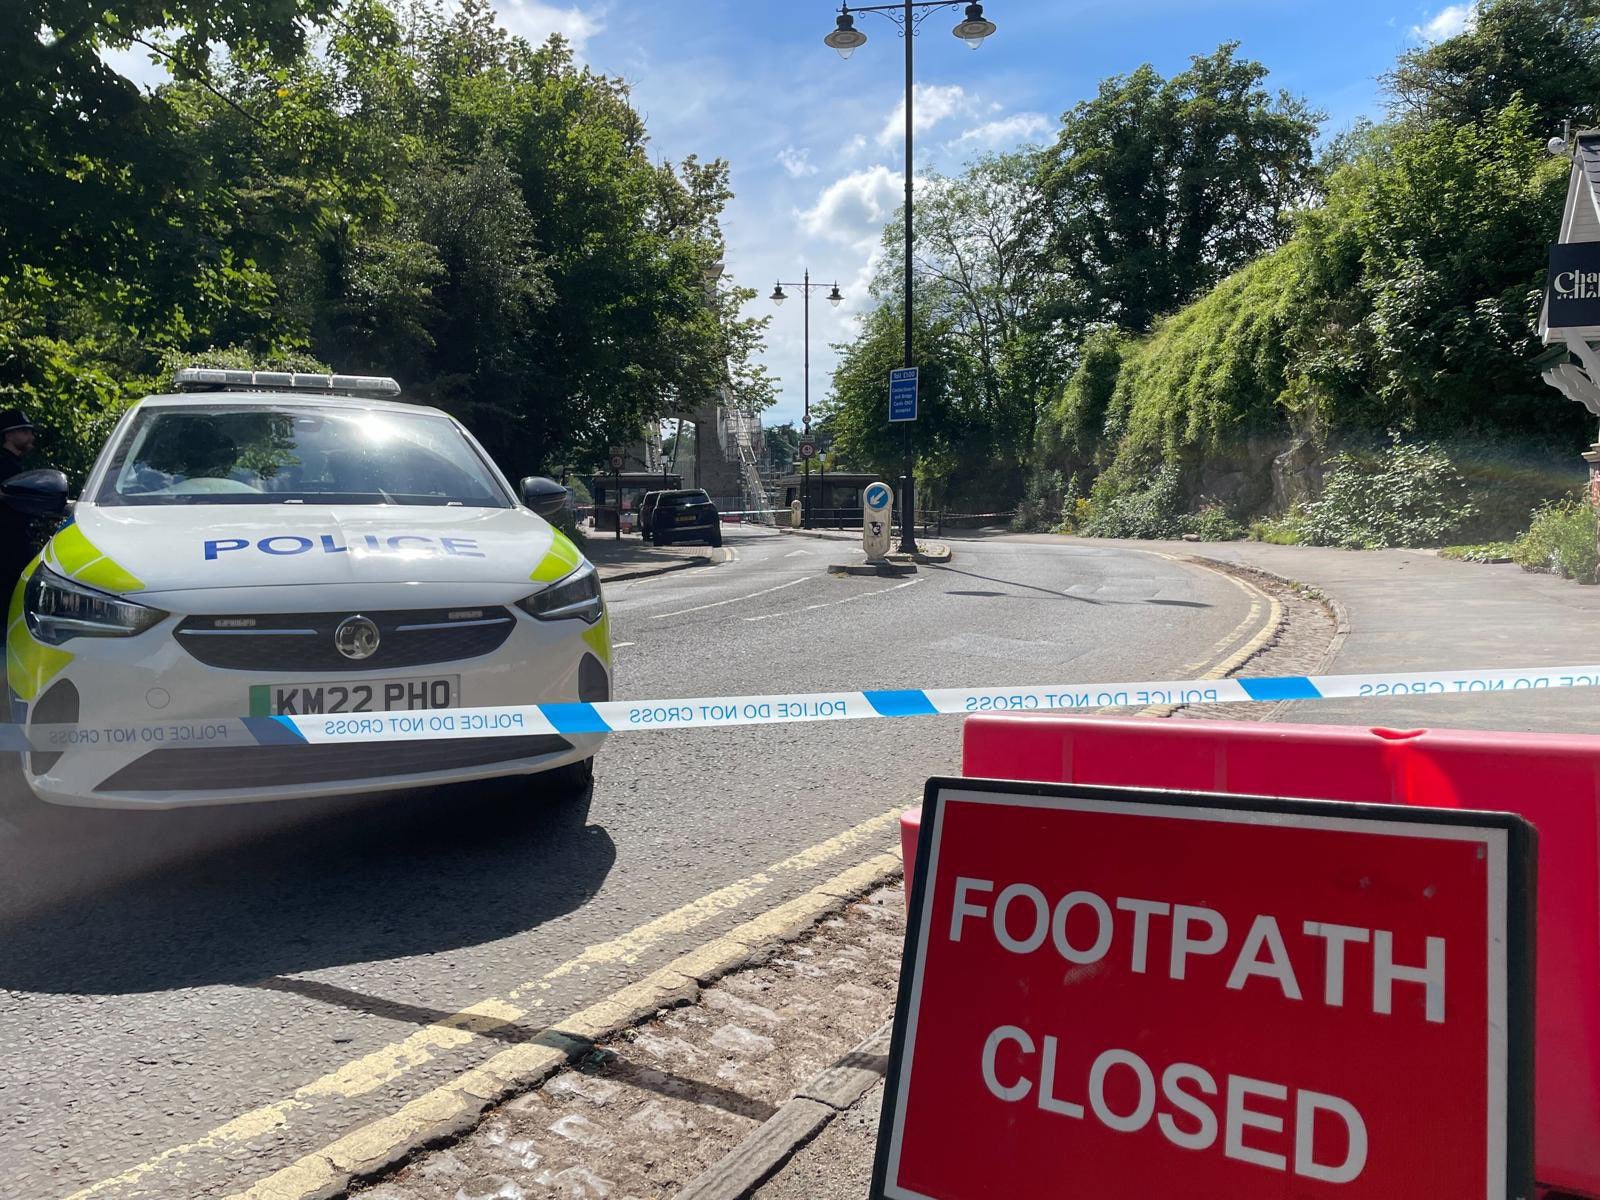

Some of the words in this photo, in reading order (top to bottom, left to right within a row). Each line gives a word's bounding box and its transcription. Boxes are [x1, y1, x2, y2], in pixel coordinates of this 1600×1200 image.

[1554, 269, 1600, 293] Cha
[204, 535, 486, 560] POLICE
[277, 685, 373, 716] KM22
[384, 680, 450, 712] PHO
[949, 876, 1446, 1024] FOOTPATH
[981, 1024, 1369, 1184] CLOSED
